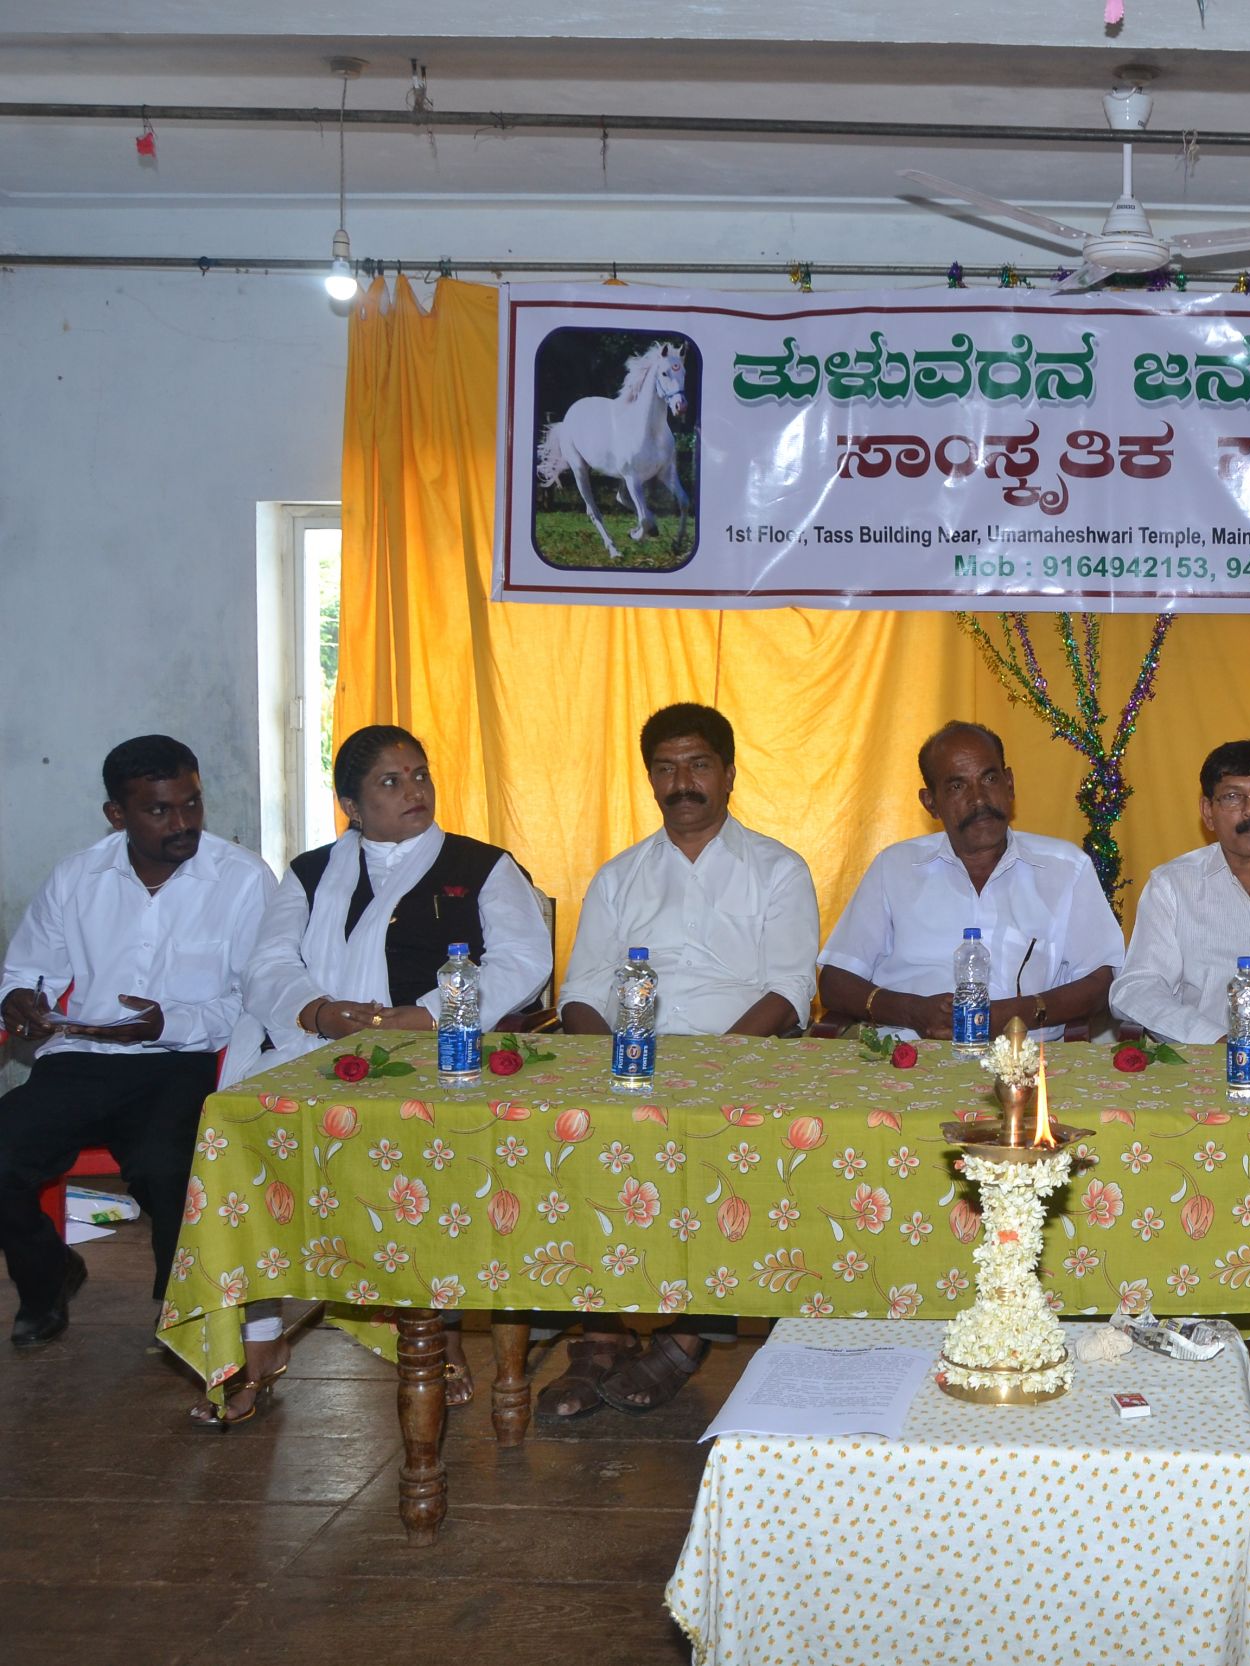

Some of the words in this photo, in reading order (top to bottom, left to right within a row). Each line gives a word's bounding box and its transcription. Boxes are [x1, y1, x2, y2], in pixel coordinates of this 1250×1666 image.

[732, 330, 1097, 402] ತುಳುವೆರೆನ
[836, 419, 1175, 516] ಸಾಂಸ್ಕೃತಿಕ
[725, 525, 752, 543] 1st
[758, 525, 808, 546] Floor,
[813, 526, 854, 543] Tass
[859, 526, 932, 547] Building
[938, 525, 981, 545] Near,
[987, 525, 1133, 545] Umamaheshwari
[1138, 526, 1206, 547] Temple,
[954, 555, 1015, 577] Mob
[1042, 555, 1216, 582] 9164942153,
